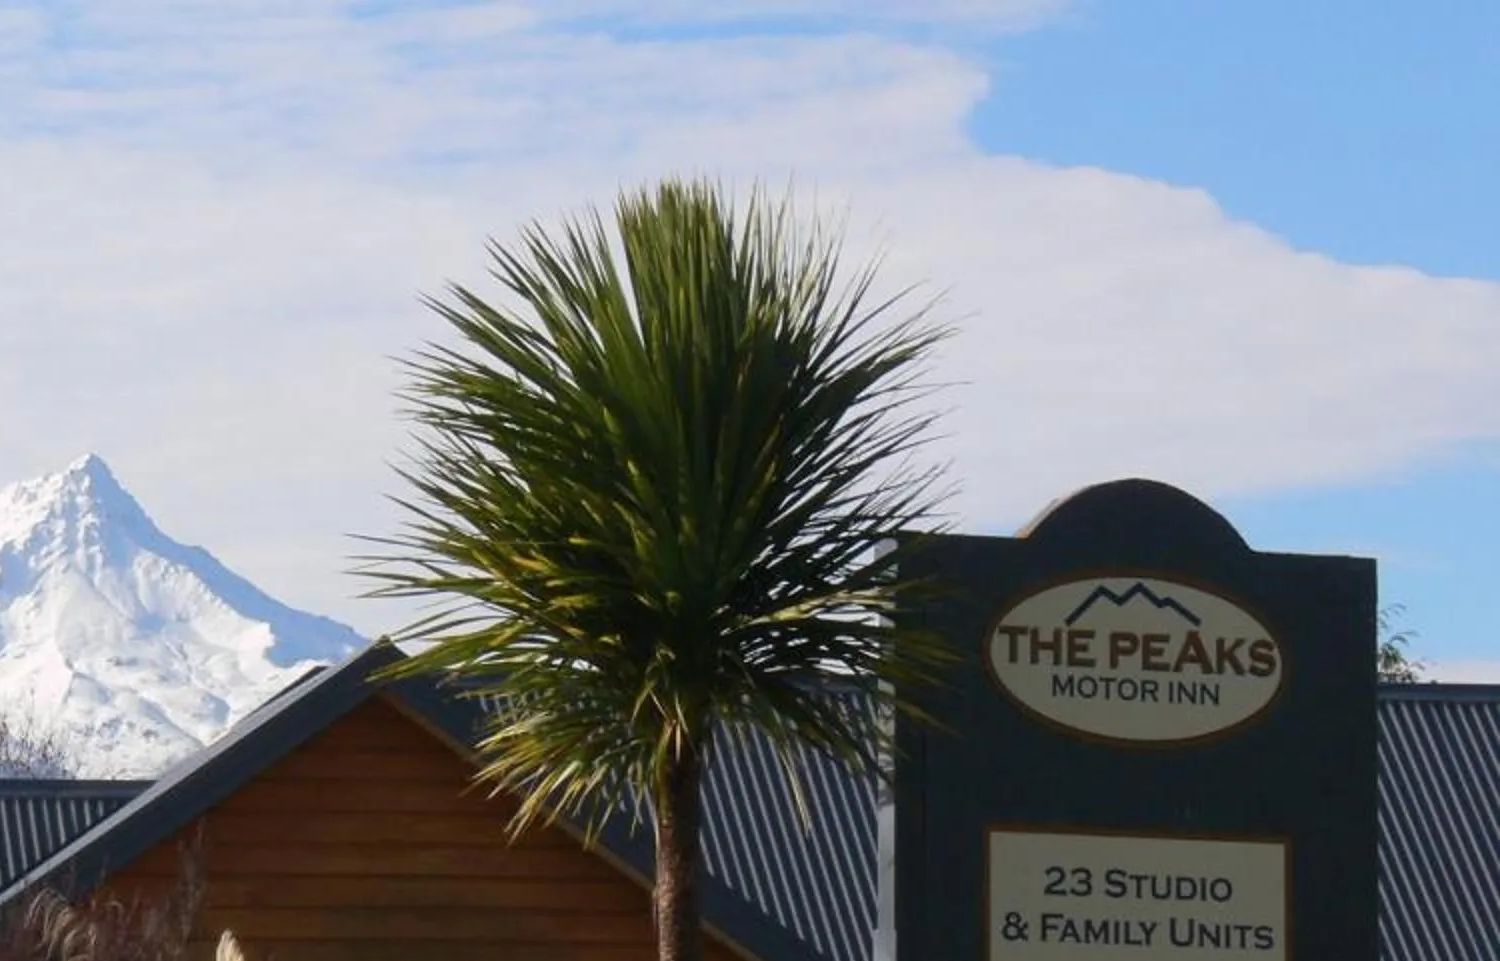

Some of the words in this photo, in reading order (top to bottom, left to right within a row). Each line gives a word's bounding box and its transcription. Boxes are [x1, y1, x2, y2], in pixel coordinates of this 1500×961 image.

[999, 625, 1096, 668] THE
[1108, 629, 1278, 677] PEAKS
[1051, 673, 1159, 702] MOTOR
[1168, 681, 1220, 705] INN
[1044, 866, 1092, 897] 23
[1105, 868, 1233, 902] STUDIO
[1002, 911, 1029, 941] &
[1040, 913, 1157, 946] FAMILY
[1169, 917, 1274, 949] UNITS
